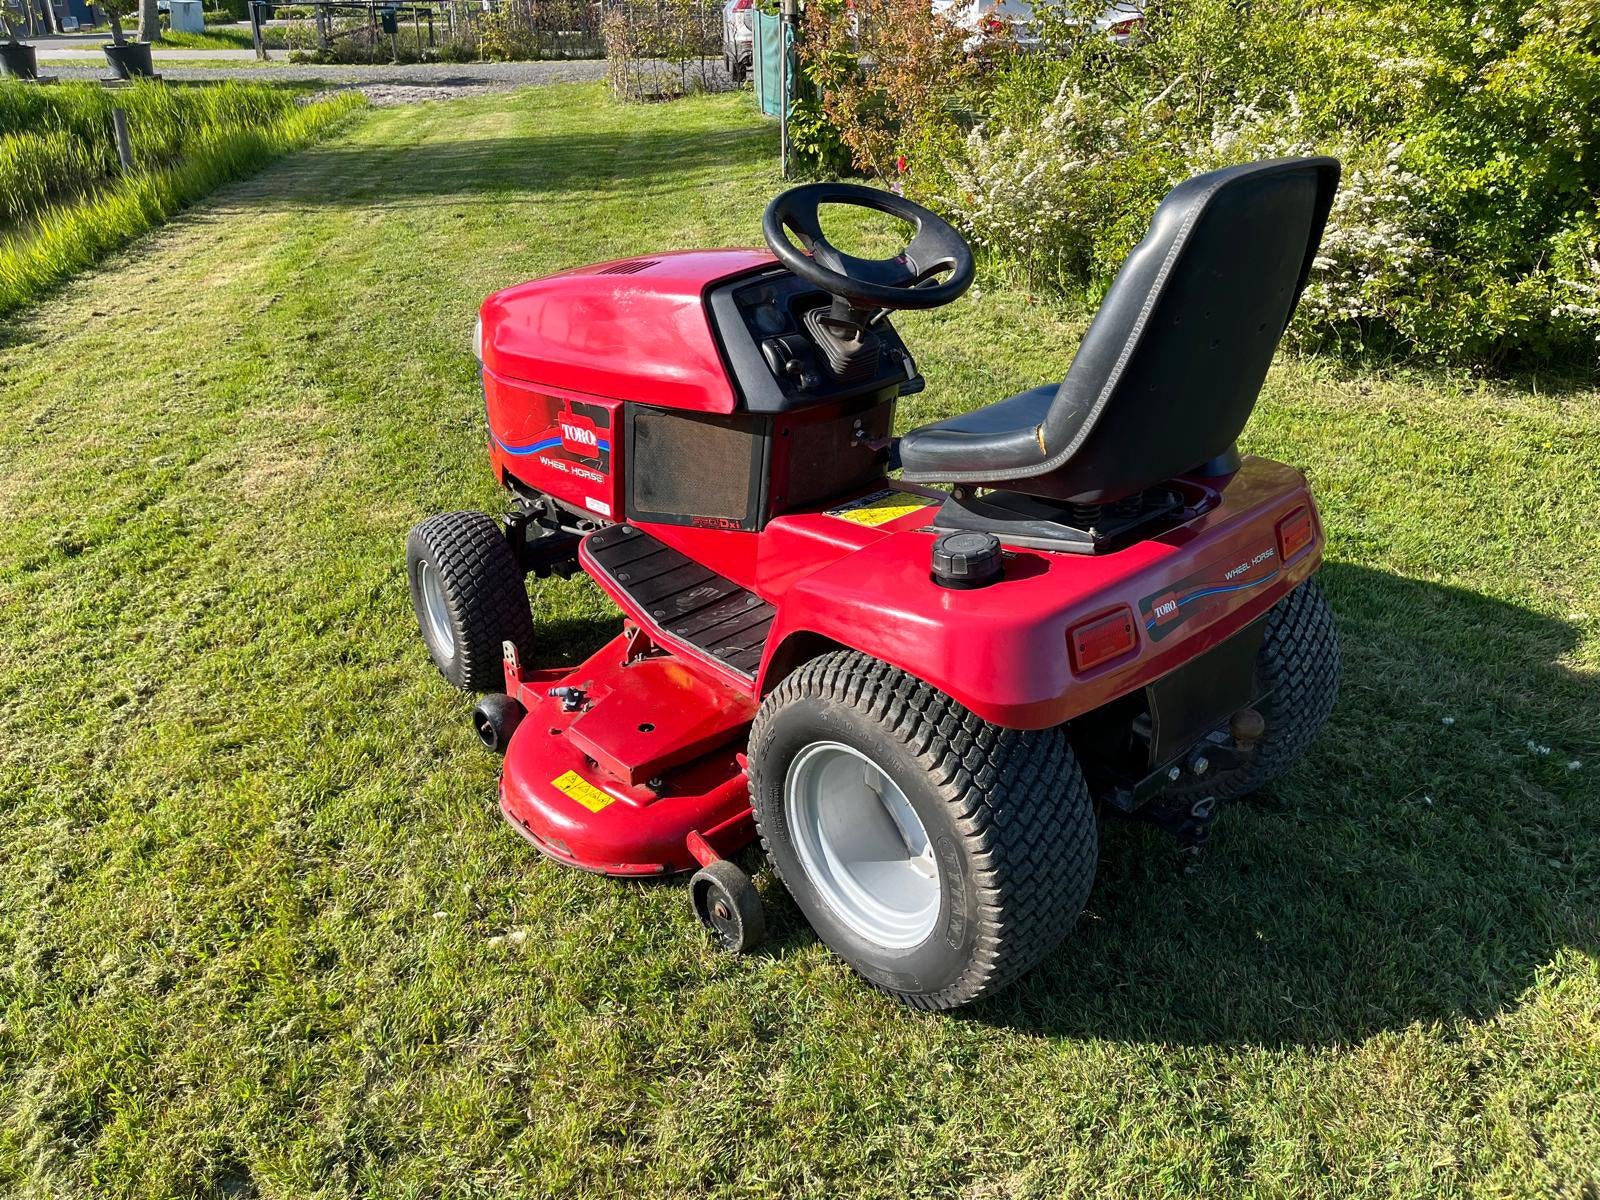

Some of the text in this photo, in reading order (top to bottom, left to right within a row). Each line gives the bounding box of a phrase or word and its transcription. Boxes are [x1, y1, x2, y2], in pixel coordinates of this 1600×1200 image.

[562, 424, 597, 446] TORO
[539, 456, 604, 484] WHEEL HORSE
[1225, 549, 1275, 581] WHEEL HORSE
[1154, 600, 1177, 618] TORO
